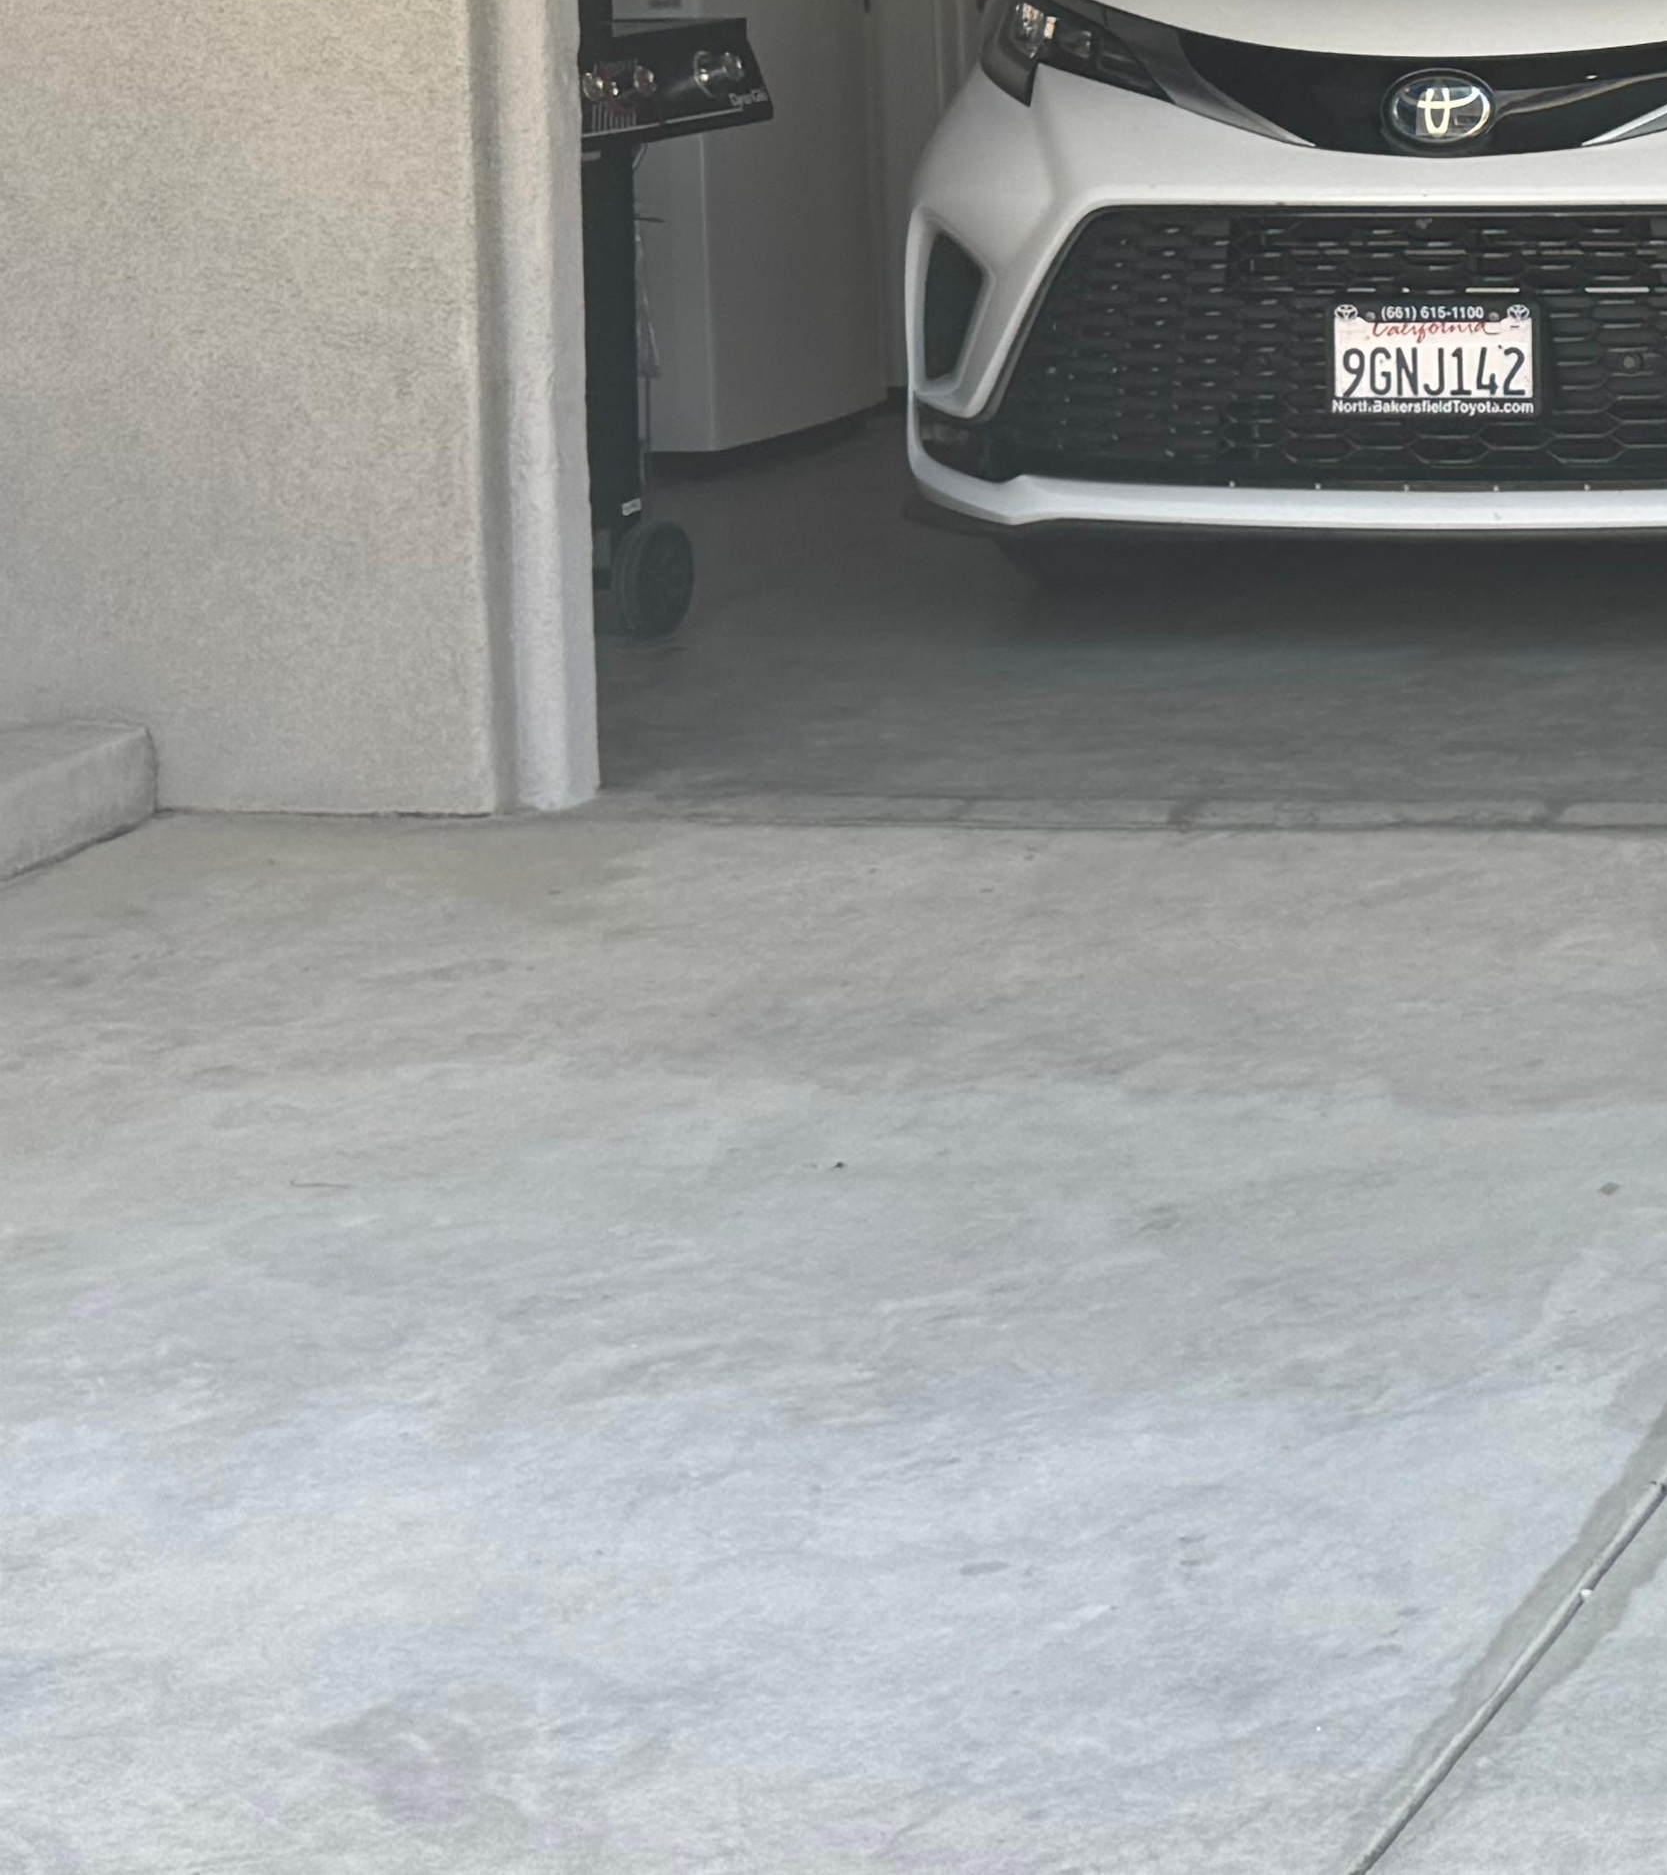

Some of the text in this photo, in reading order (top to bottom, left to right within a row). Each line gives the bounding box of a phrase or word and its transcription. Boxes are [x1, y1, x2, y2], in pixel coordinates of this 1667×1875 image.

[1380, 305, 1485, 321] (661) 615-1100
[1342, 346, 1527, 397] 9GNJ142
